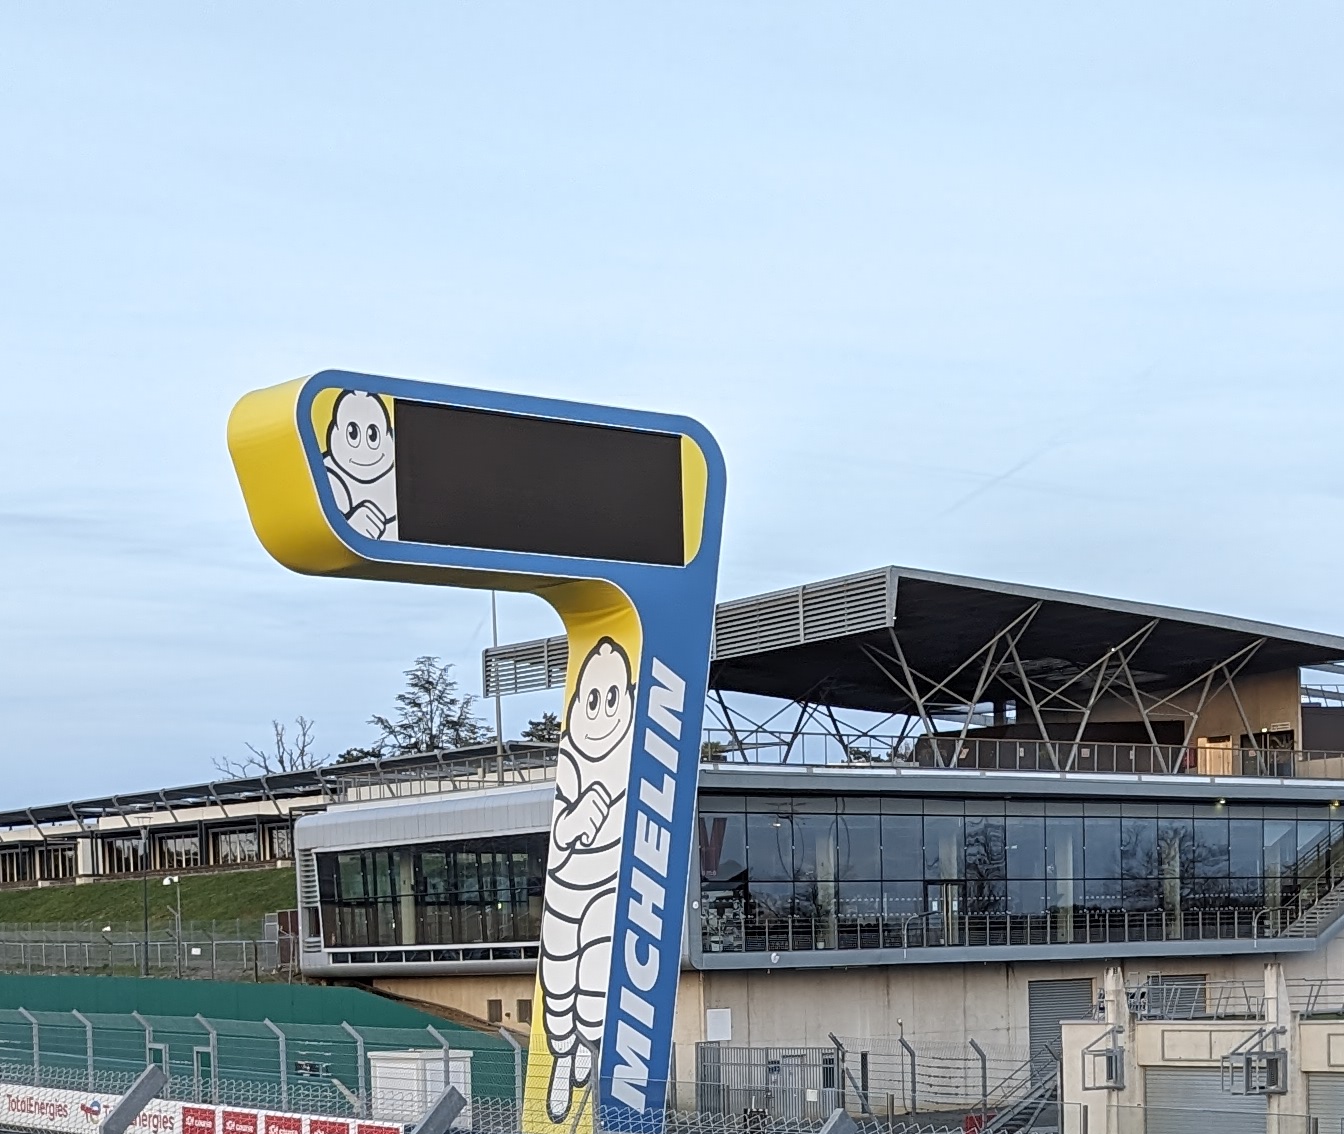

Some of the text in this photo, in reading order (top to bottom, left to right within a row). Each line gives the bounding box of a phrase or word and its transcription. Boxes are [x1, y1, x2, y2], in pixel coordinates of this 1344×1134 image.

[611, 656, 687, 1115] MICHELIN
[6, 1094, 69, 1121] TotalEnergies
[102, 1104, 175, 1134] Tnergies
